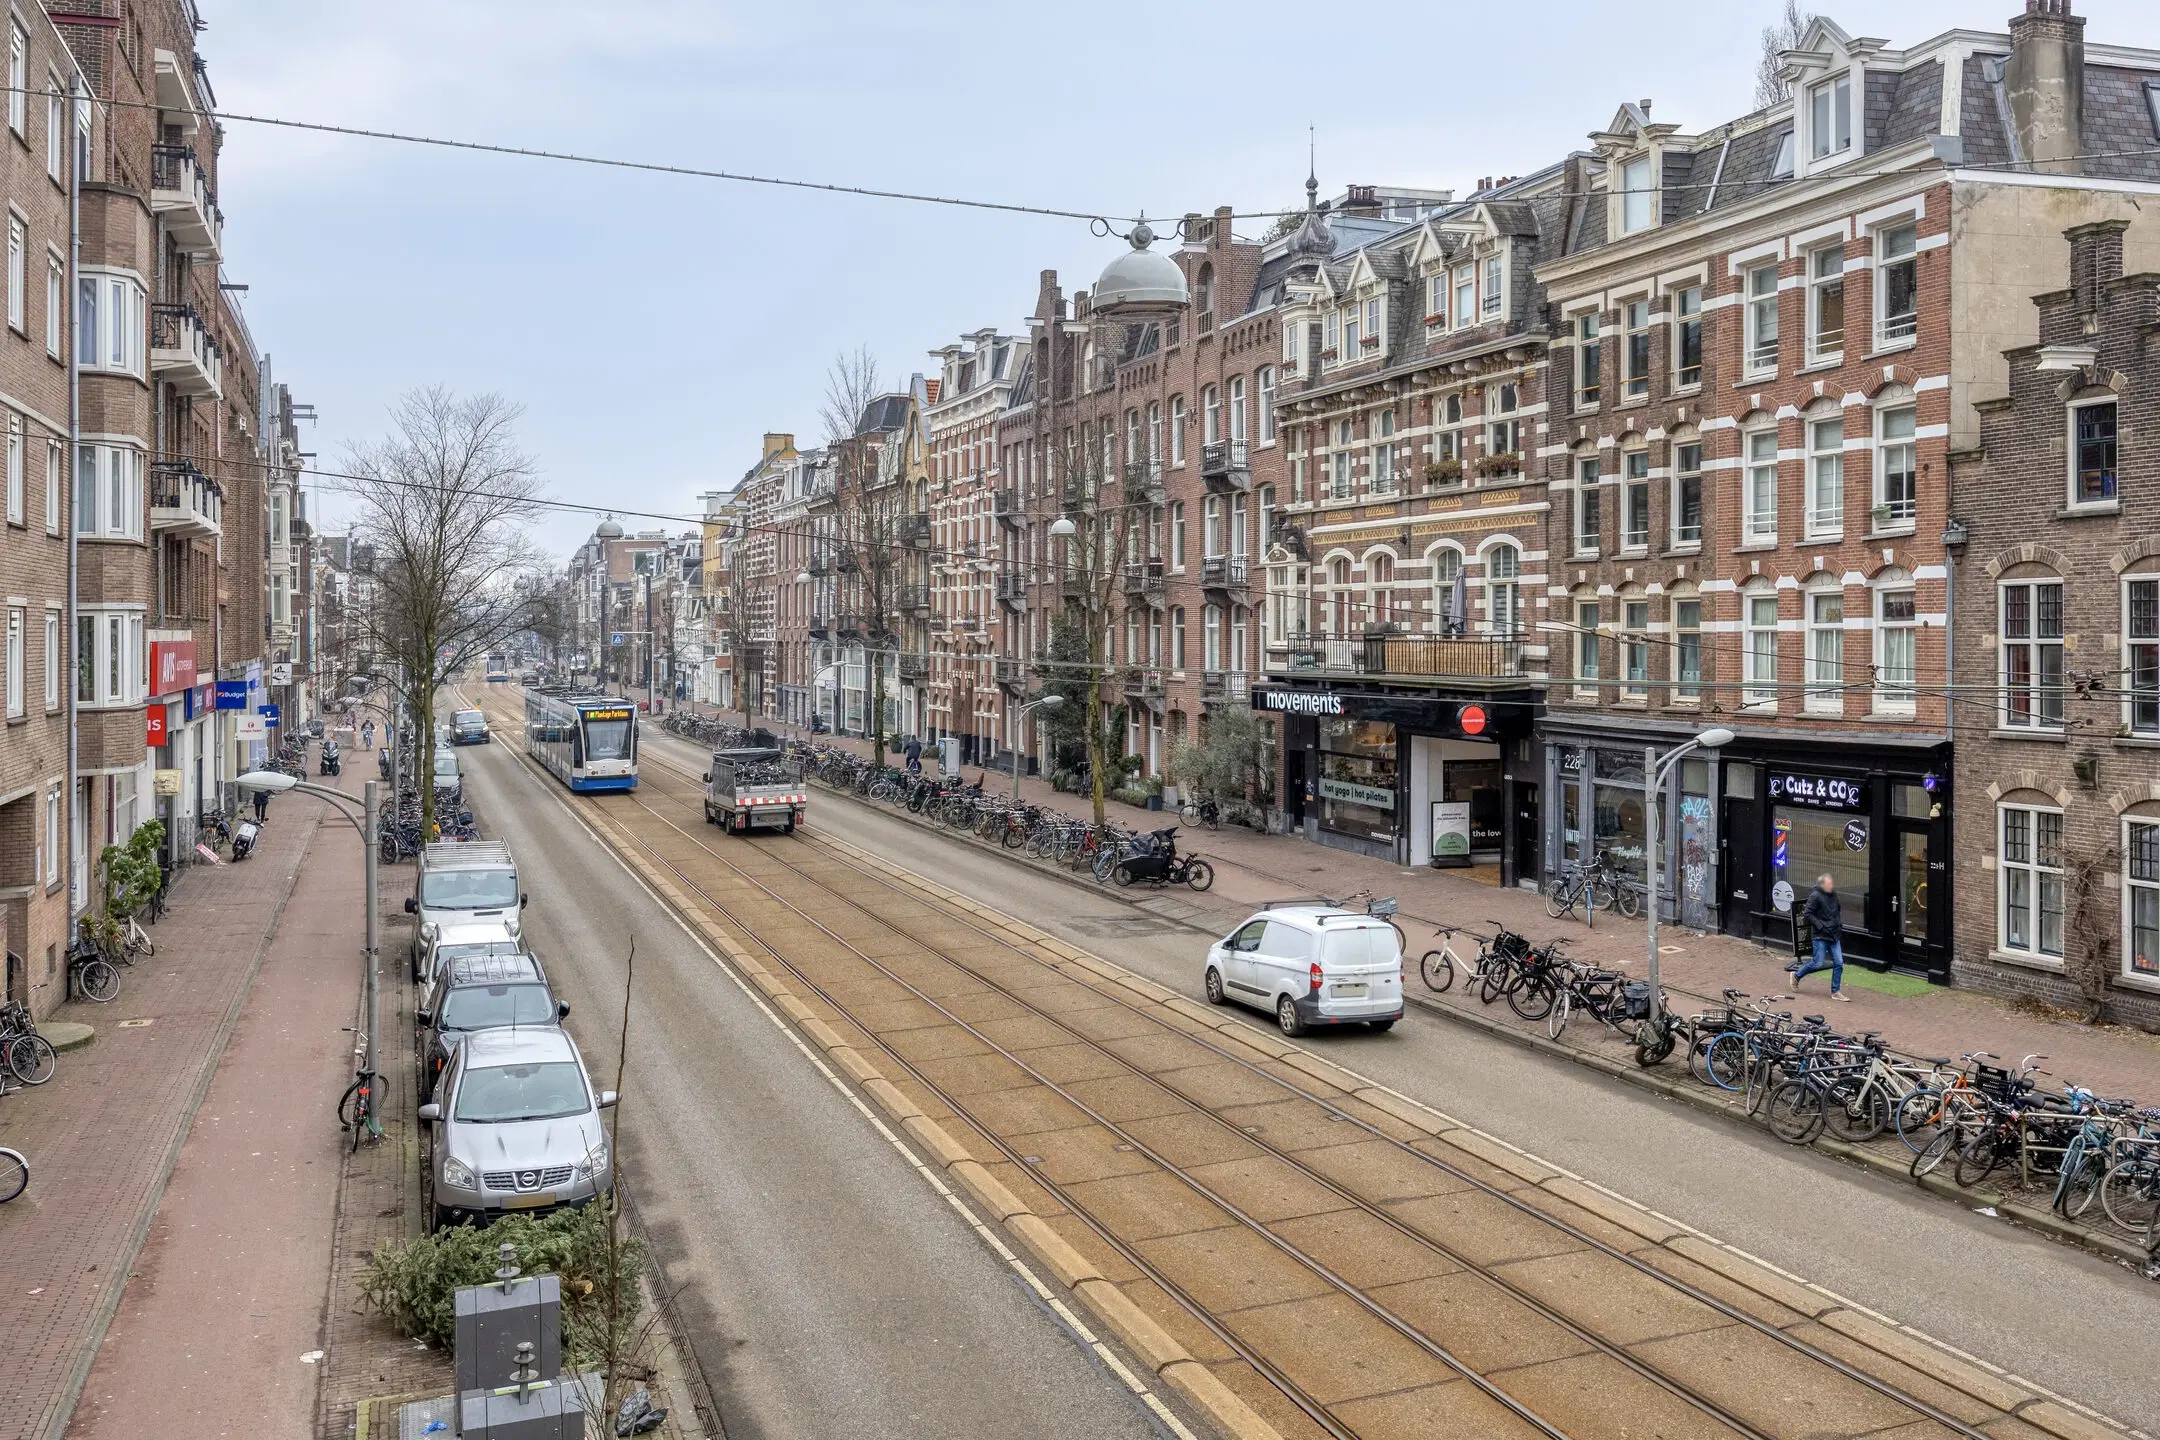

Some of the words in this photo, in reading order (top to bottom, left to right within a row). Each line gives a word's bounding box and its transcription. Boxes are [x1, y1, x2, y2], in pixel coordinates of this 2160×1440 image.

[163, 652, 175, 683] AVIS
[224, 691, 246, 699] Budget
[1324, 782, 1334, 793] hot
[1335, 786, 1350, 797] yoga
[1355, 788, 1365, 798] hot
[1366, 790, 1388, 803] pilates
[1786, 776, 1814, 795] Cutz
[1816, 779, 1826, 797] &
[1829, 780, 1847, 799] CO
[1472, 829, 1486, 837] the
